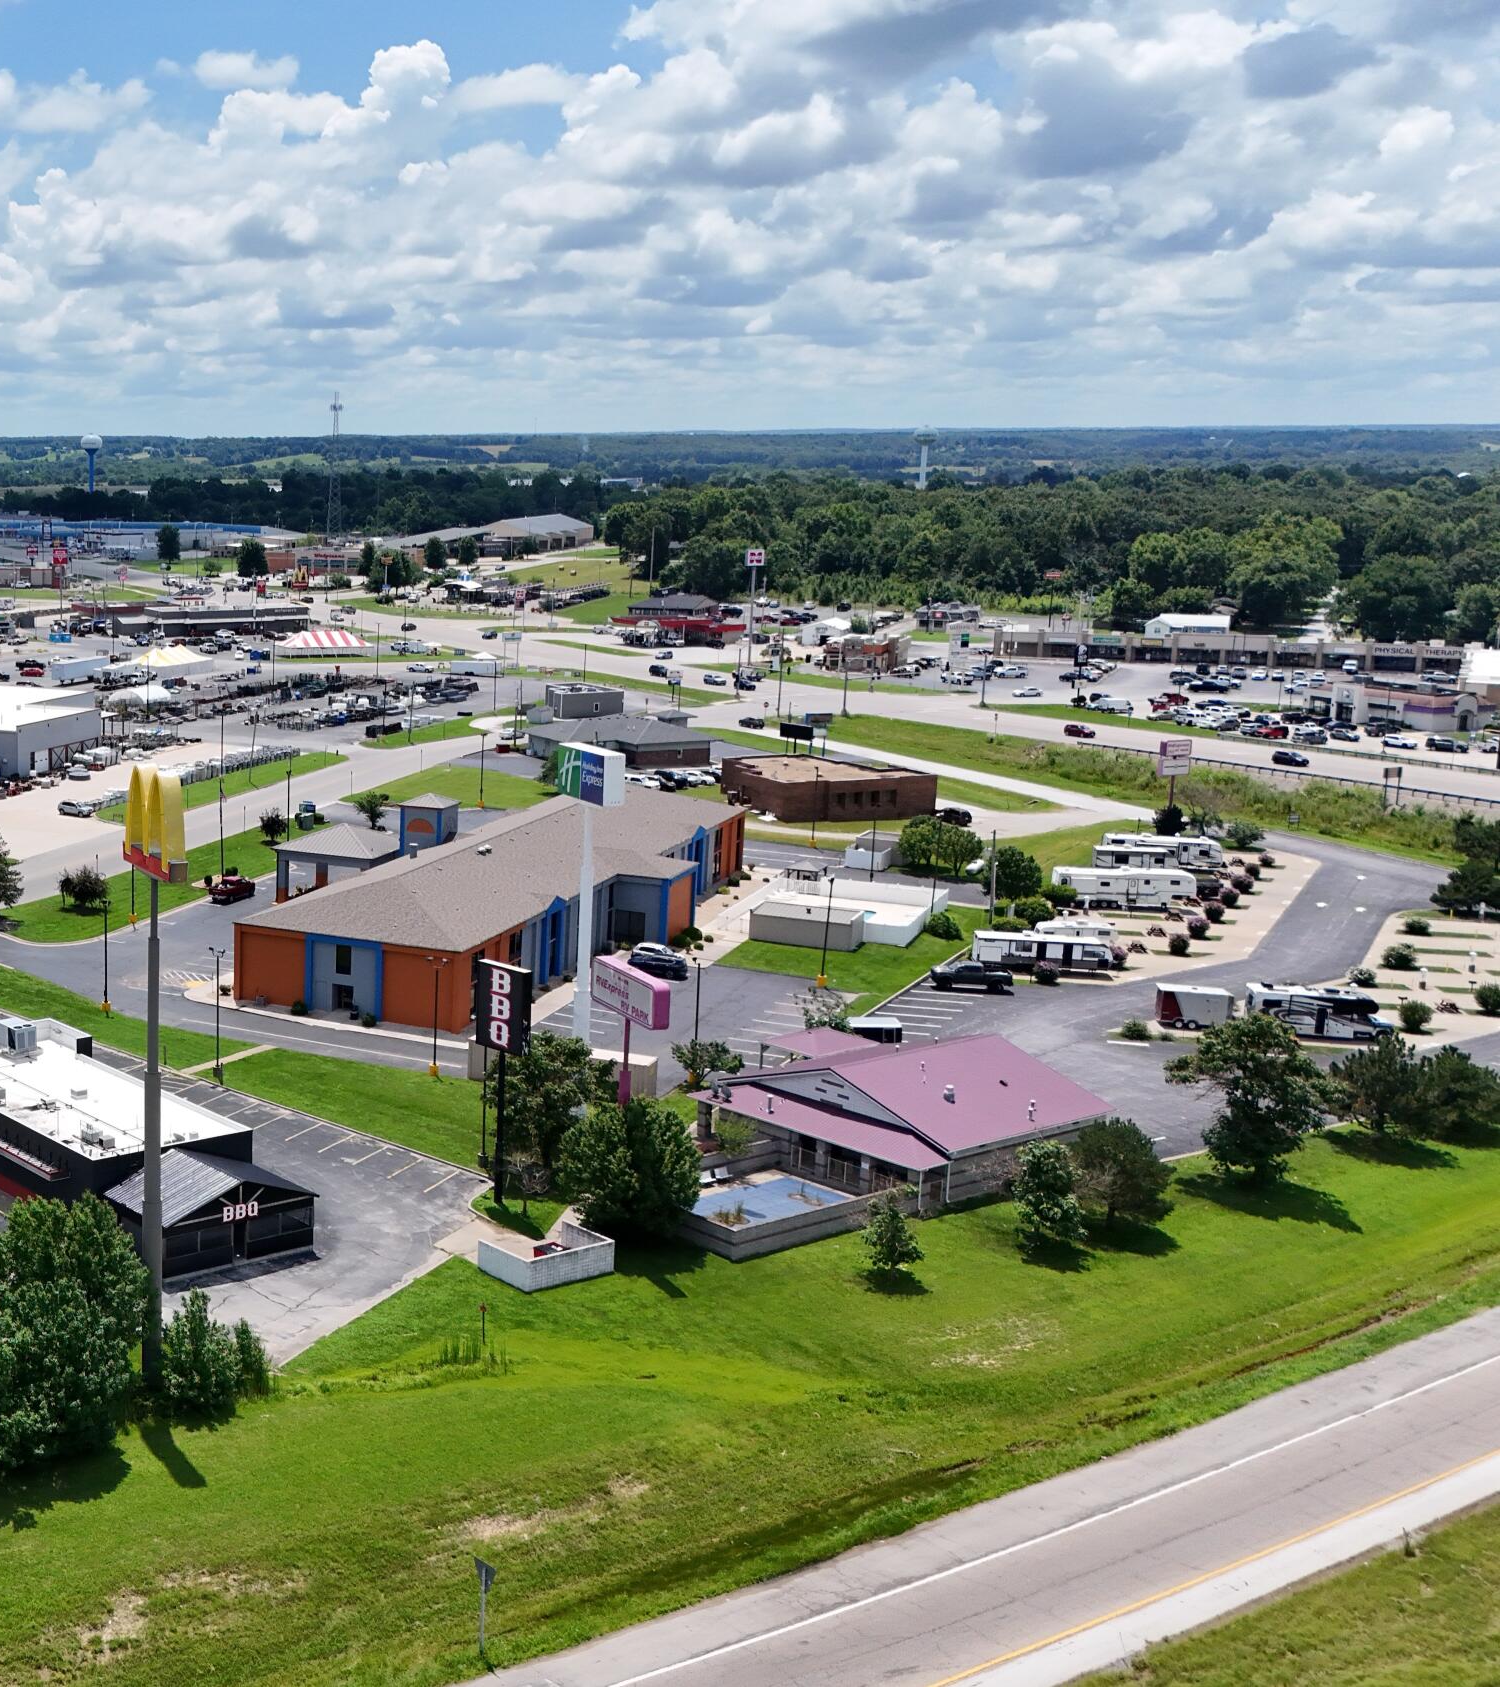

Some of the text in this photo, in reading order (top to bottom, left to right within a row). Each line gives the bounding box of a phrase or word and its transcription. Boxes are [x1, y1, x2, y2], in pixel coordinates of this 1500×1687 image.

[1374, 647, 1464, 657] PHYSICAL THERAPY
[582, 770, 603, 788] Express
[489, 967, 511, 1049] BBQ
[631, 1005, 649, 1022] PARK
[222, 1201, 259, 1223] BBQ
